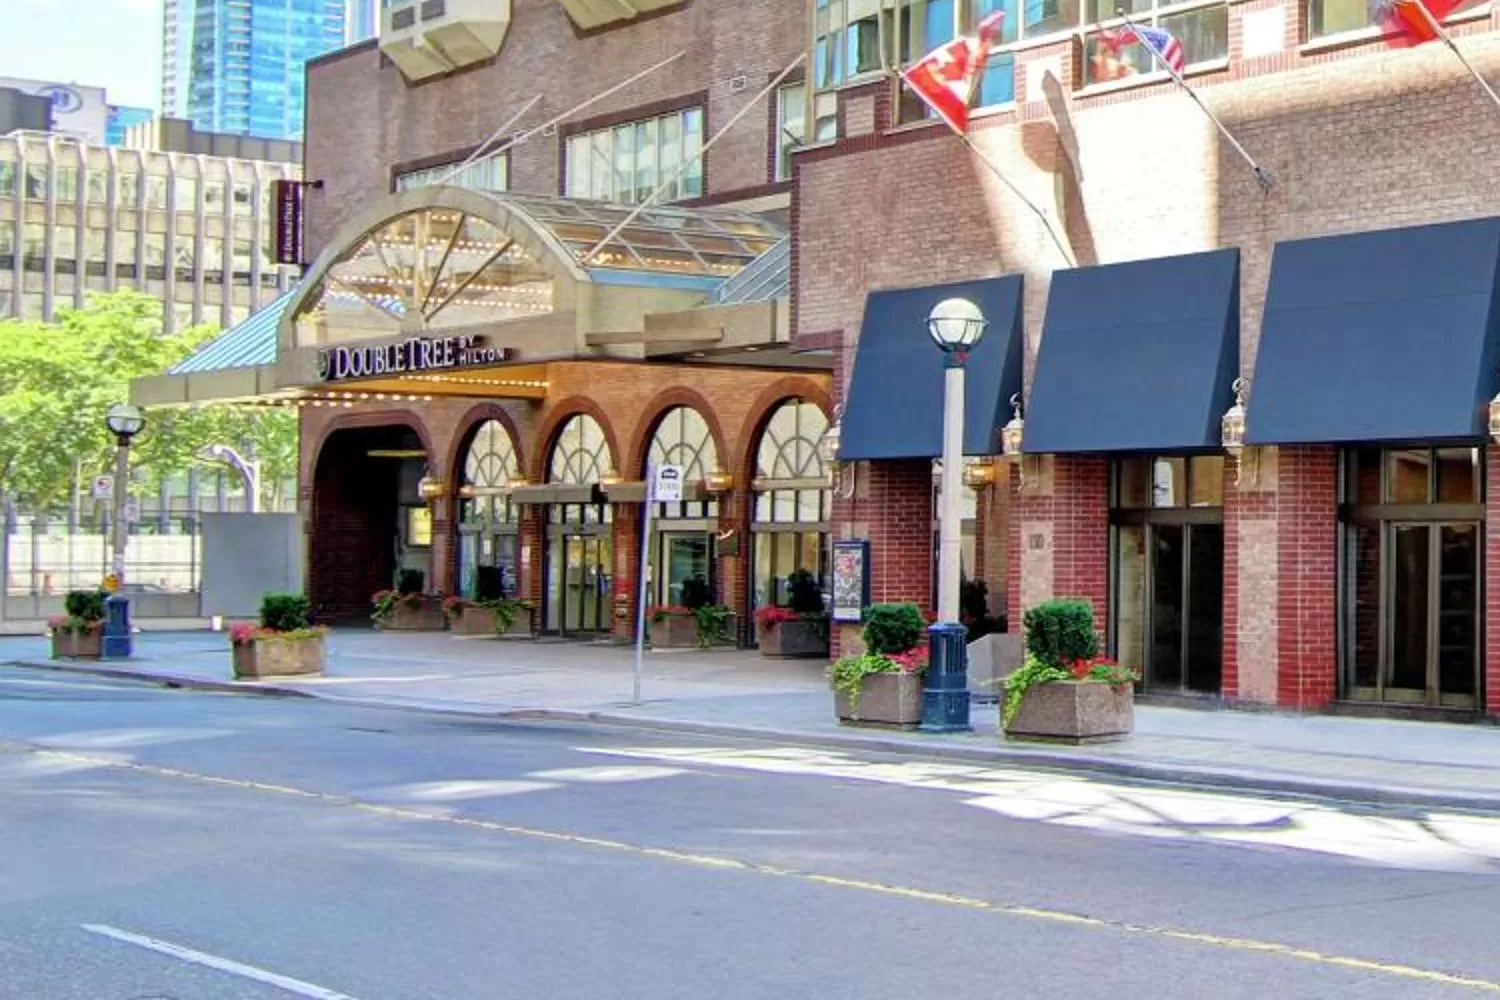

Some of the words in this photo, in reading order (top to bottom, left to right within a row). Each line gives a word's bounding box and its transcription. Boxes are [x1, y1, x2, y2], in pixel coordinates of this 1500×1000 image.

[460, 335, 475, 348] BY
[335, 337, 455, 379] DOUBLETREE
[460, 347, 504, 364] HILTON
